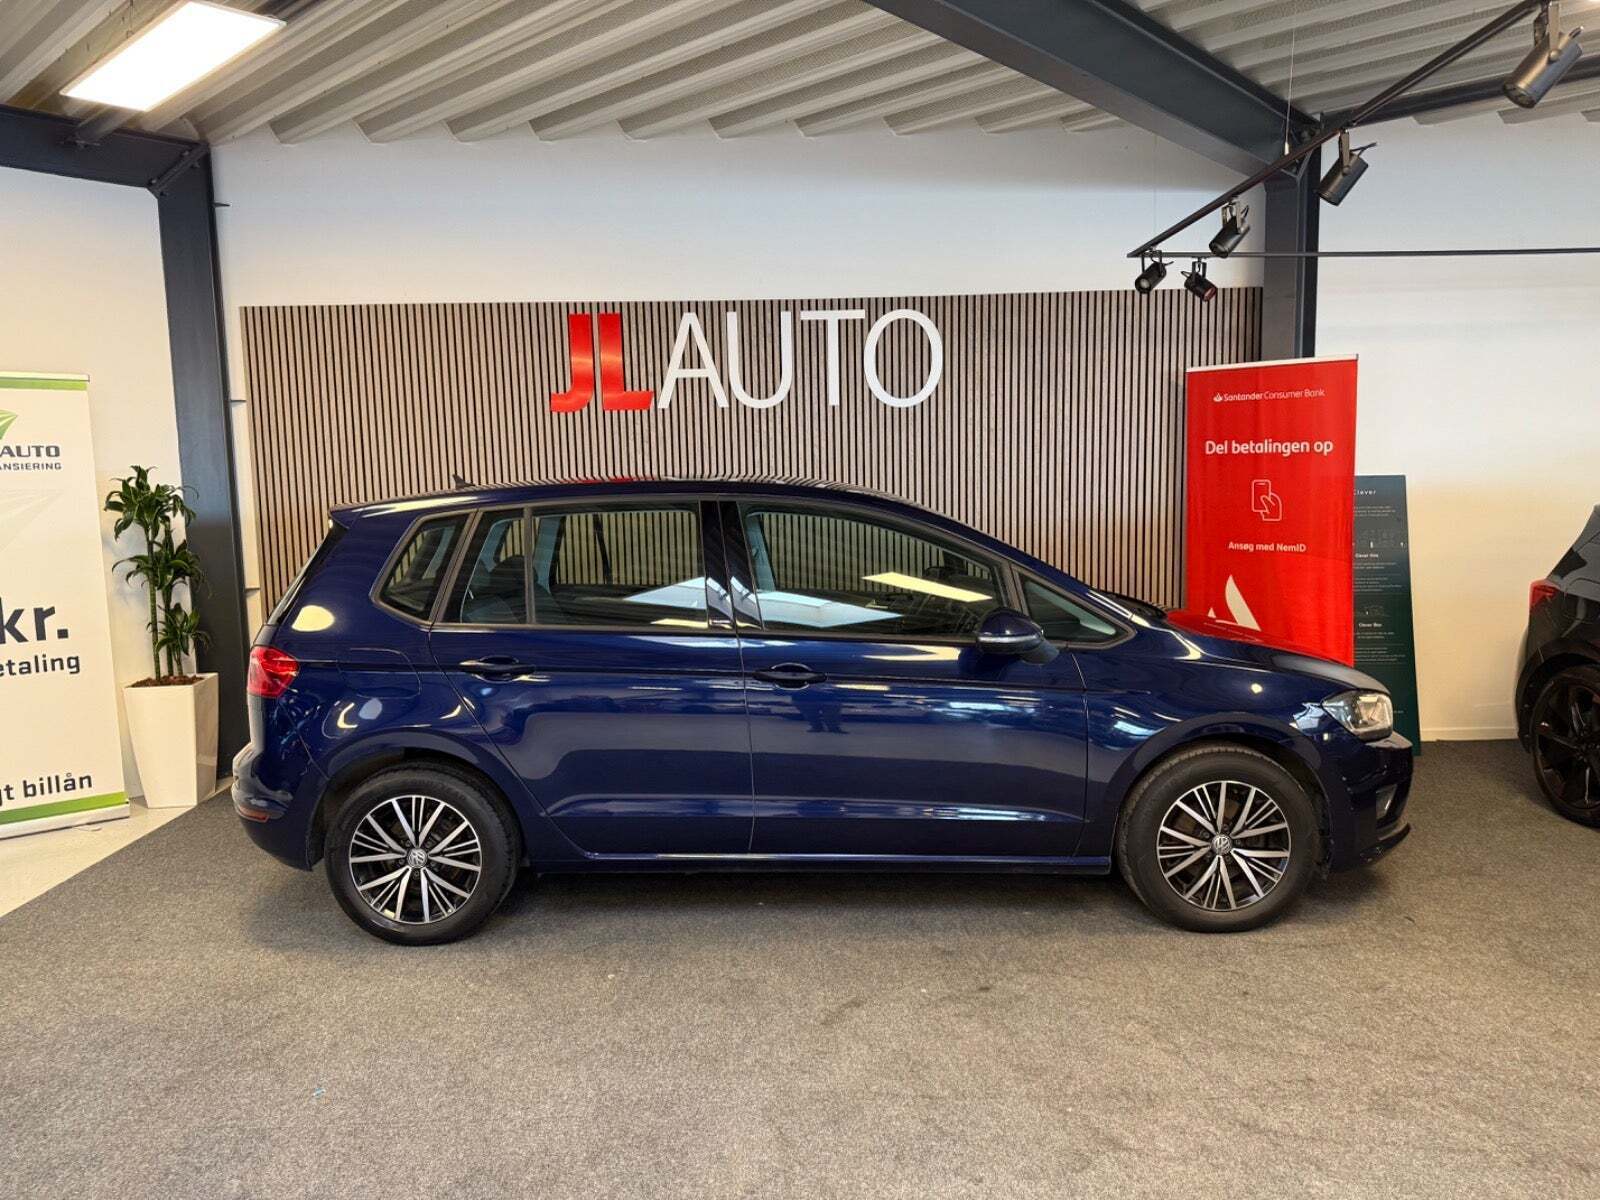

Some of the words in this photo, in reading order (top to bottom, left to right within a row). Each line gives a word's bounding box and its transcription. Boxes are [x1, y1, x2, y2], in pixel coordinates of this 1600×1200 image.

[550, 311, 654, 413] JL
[657, 309, 943, 409] AUTO
[1223, 391, 1263, 402] Santander
[1263, 389, 1304, 400] Consumer
[1304, 388, 1326, 398] Bank
[0, 445, 61, 458] AUTO
[1205, 439, 1228, 455] Del
[1231, 438, 1309, 457] betalingen
[1313, 440, 1334, 456] op
[1228, 541, 1254, 552] Ansøg
[1256, 542, 1275, 551] med
[1276, 543, 1307, 553] NemID
[0, 596, 69, 644] kr.
[23, 772, 92, 798] billån
